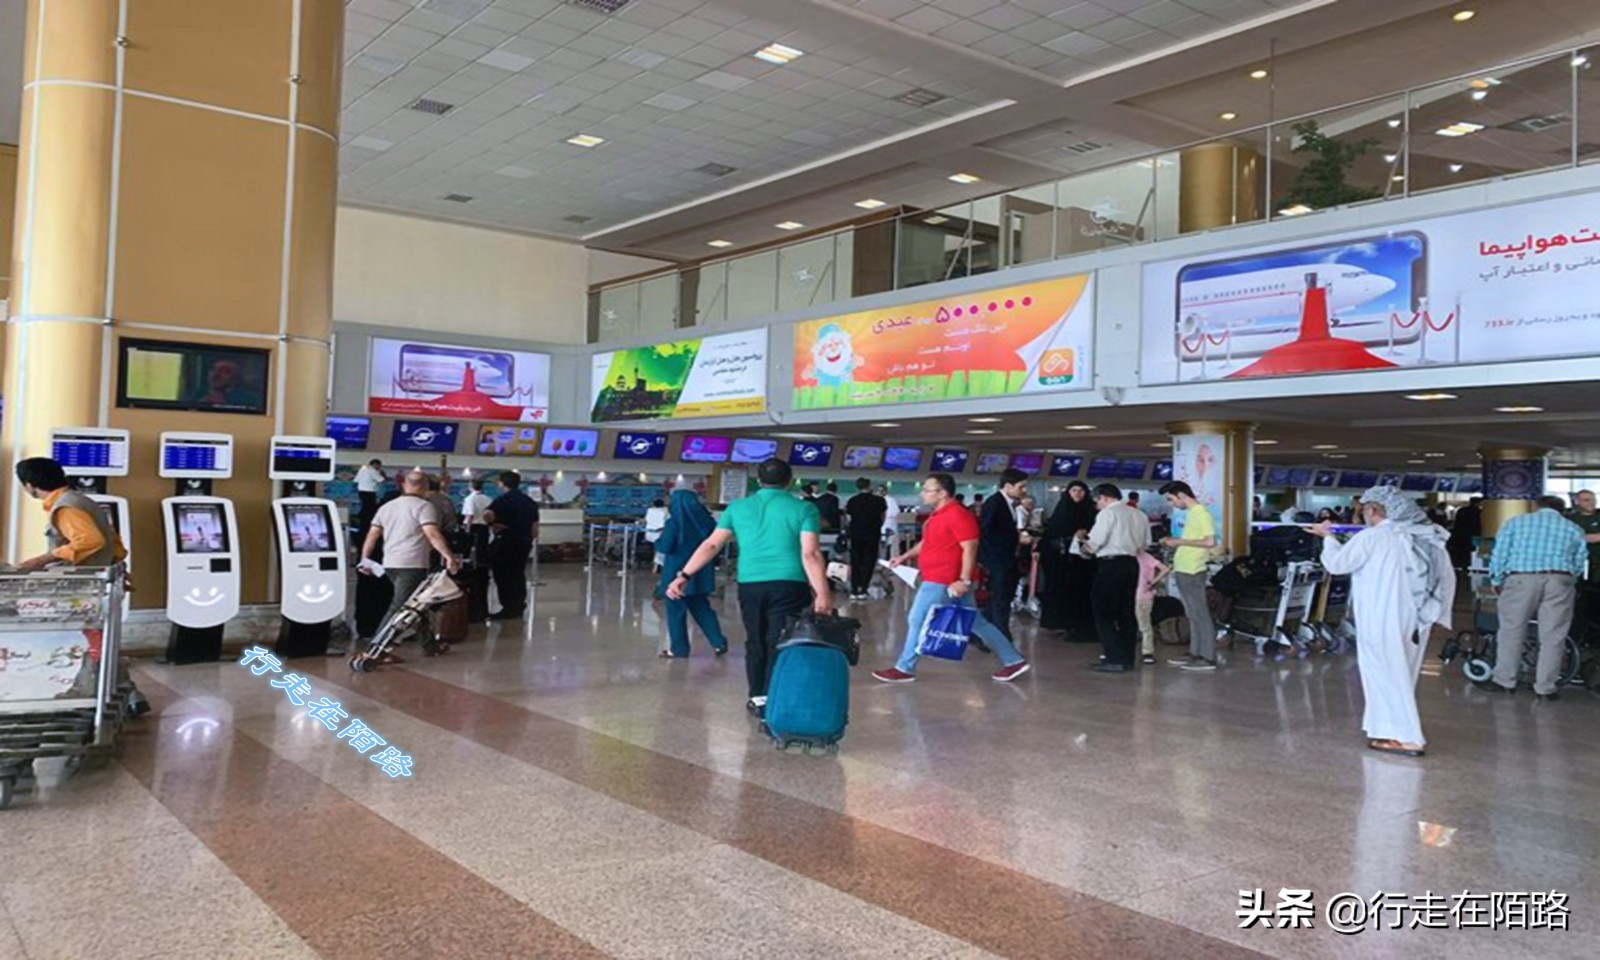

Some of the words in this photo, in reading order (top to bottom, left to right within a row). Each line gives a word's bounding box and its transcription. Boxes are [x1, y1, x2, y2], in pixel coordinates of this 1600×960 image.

[400, 423, 408, 432] 8
[445, 426, 453, 435] 9
[620, 434, 632, 443] 10
